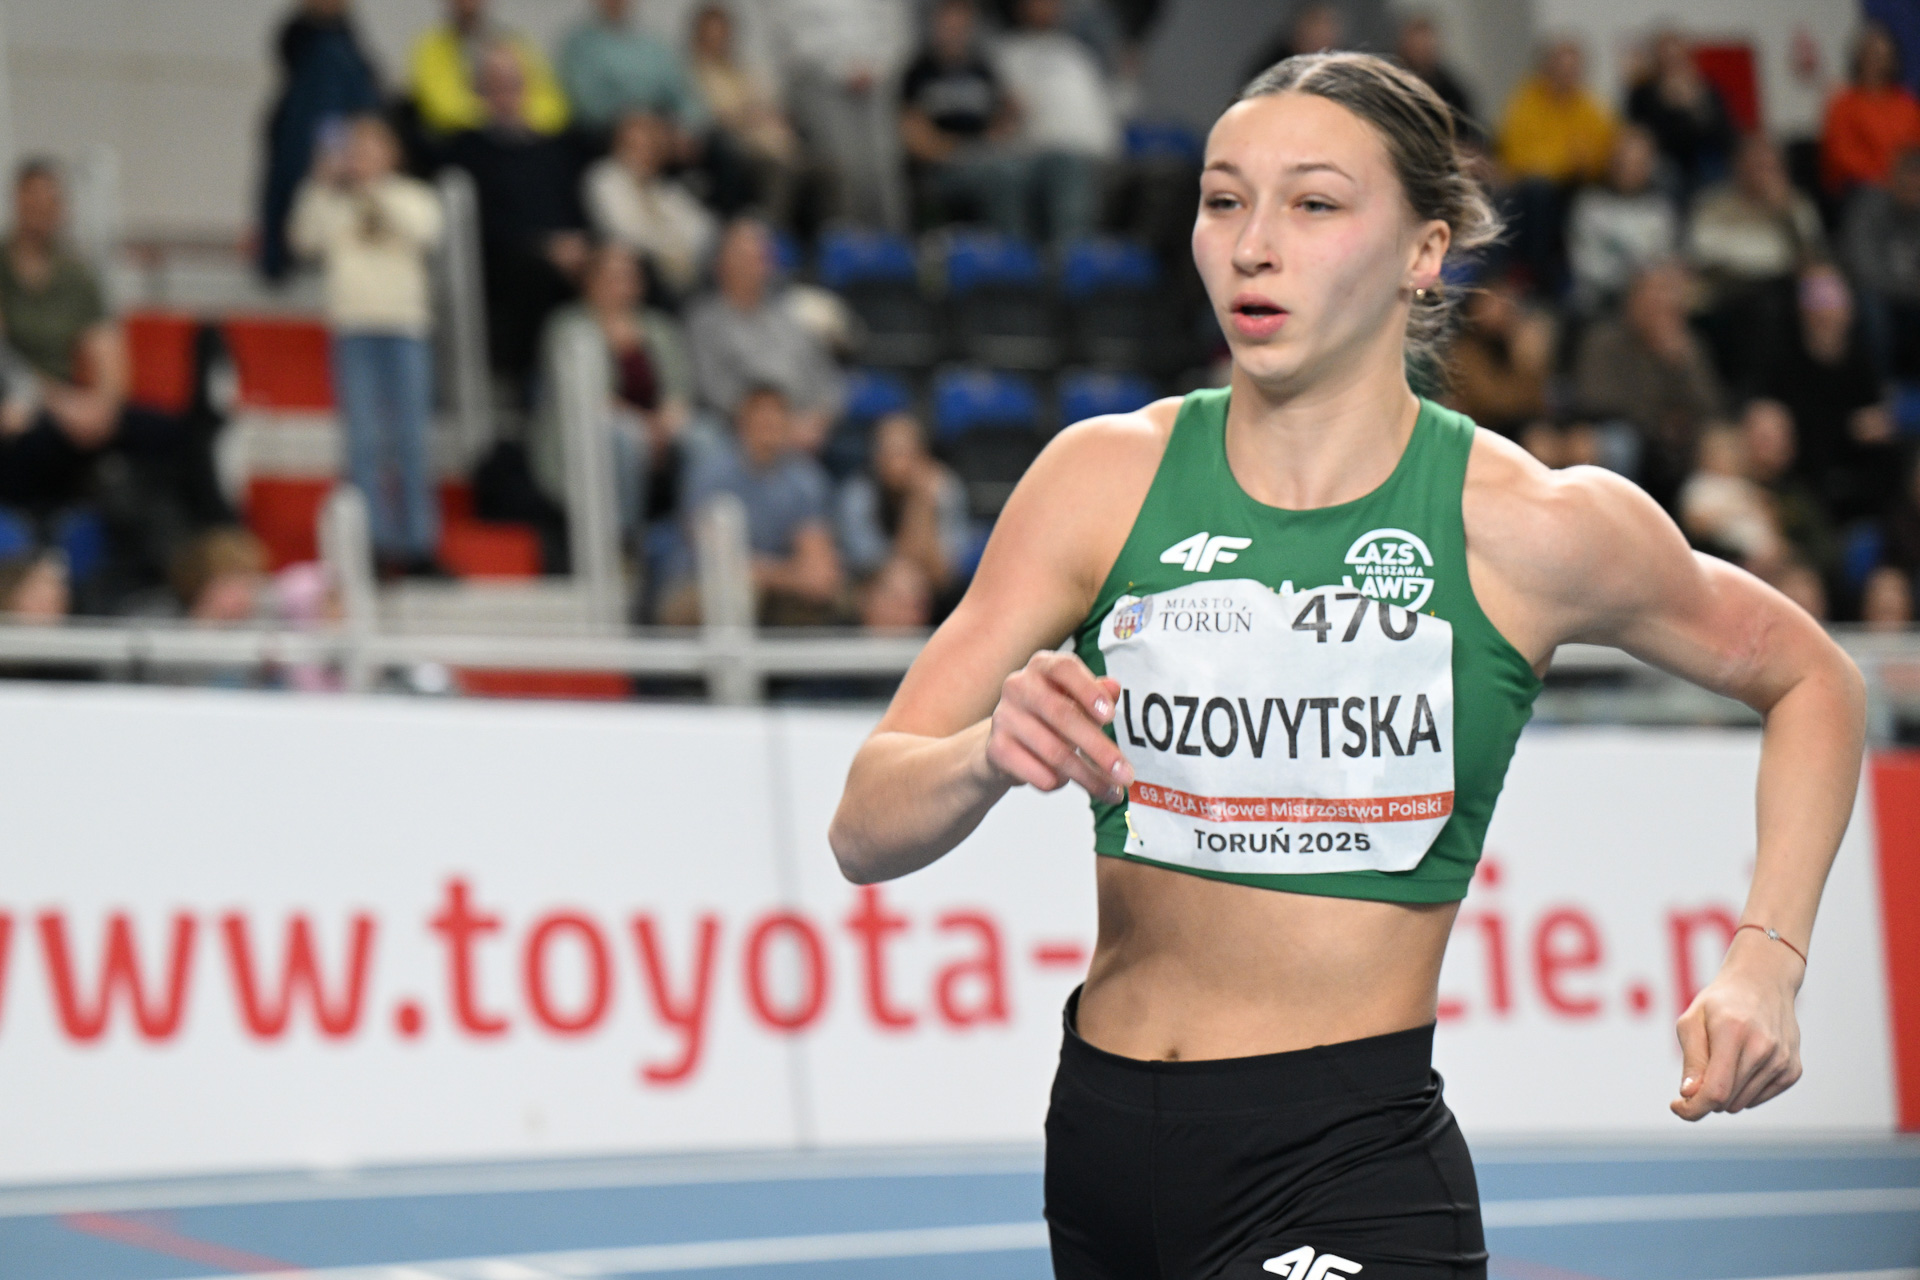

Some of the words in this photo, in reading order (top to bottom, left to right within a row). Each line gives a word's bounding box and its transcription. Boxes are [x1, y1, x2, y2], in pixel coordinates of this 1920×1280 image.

[1160, 532, 1252, 573] 4F
[1362, 542, 1415, 566] AZS
[1355, 564, 1424, 577] WARSZAWA
[1360, 575, 1420, 600] AWF
[1165, 598, 1234, 609] MIASTO
[1292, 592, 1418, 643] 470
[1160, 605, 1252, 633] TORUŃ
[1123, 689, 1442, 760] LOZOVYTSKA
[1139, 785, 1163, 804] 69.
[1164, 791, 1197, 813] PZLA
[1271, 802, 1383, 818] Mistrzostwa
[1388, 797, 1442, 817] Polski
[1194, 827, 1290, 853] TORUŃ
[1299, 832, 1371, 854] 2025
[0, 873, 1086, 1085] ww.toyota-
